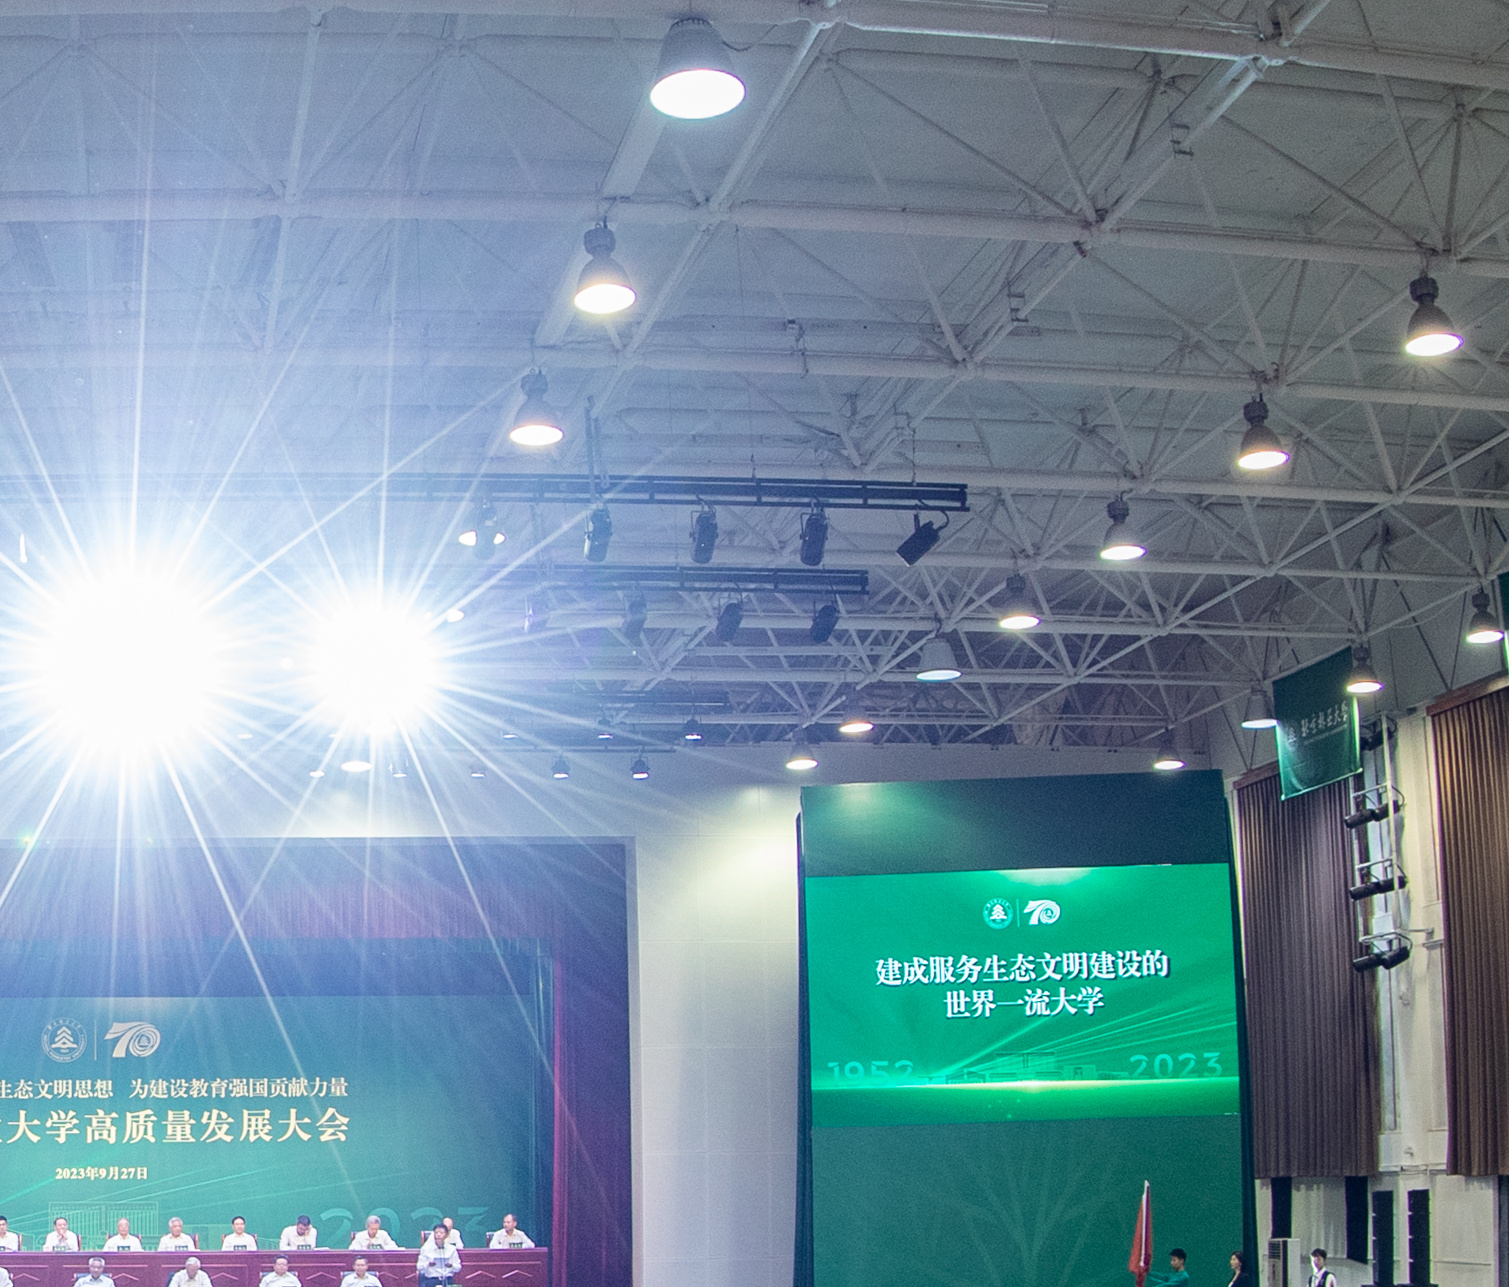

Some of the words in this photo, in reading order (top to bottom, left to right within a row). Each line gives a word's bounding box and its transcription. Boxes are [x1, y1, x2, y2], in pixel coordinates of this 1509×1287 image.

[876, 949, 1170, 986] 建成服务生态文明建设的
[944, 986, 1105, 1019] 世界一流大学
[128, 1077, 349, 1099] 为建设教育强国贡献力量
[55, 1166, 149, 1181] 2023年9月27日
